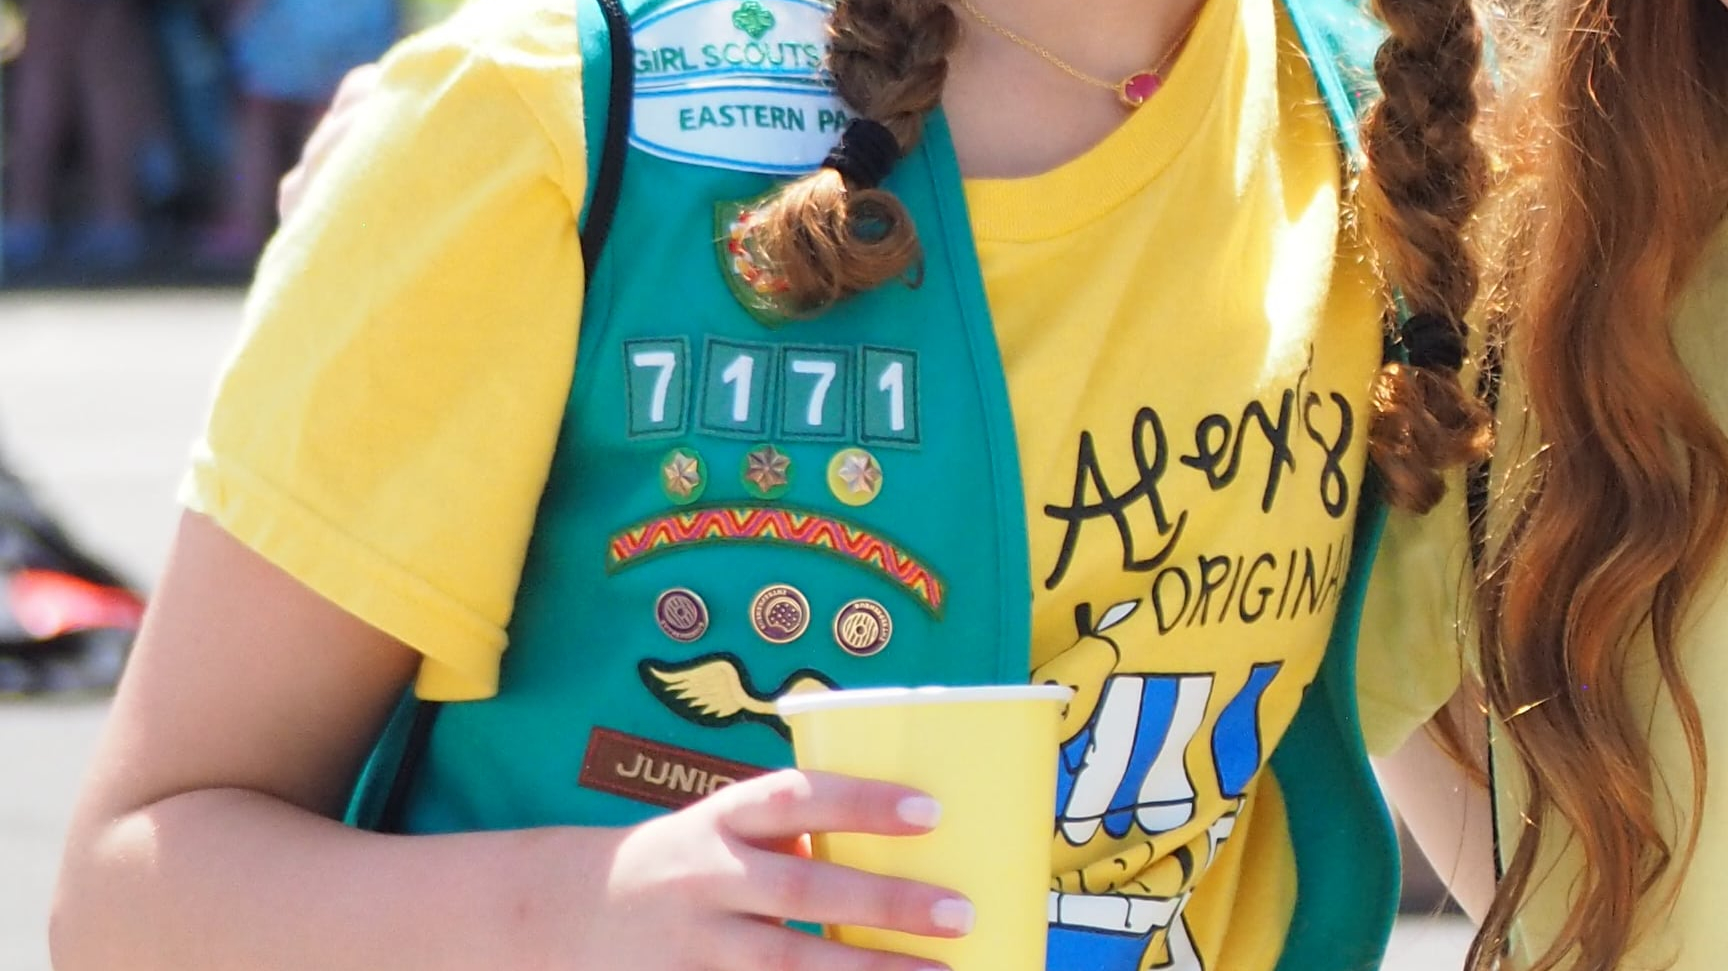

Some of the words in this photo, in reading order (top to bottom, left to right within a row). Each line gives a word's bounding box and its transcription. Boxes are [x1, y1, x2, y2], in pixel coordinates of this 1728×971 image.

[634, 46, 698, 75] GIRL
[701, 42, 821, 69] SCOUTS
[679, 104, 805, 132] EASTERN
[1151, 533, 1349, 636] ORIGINA
